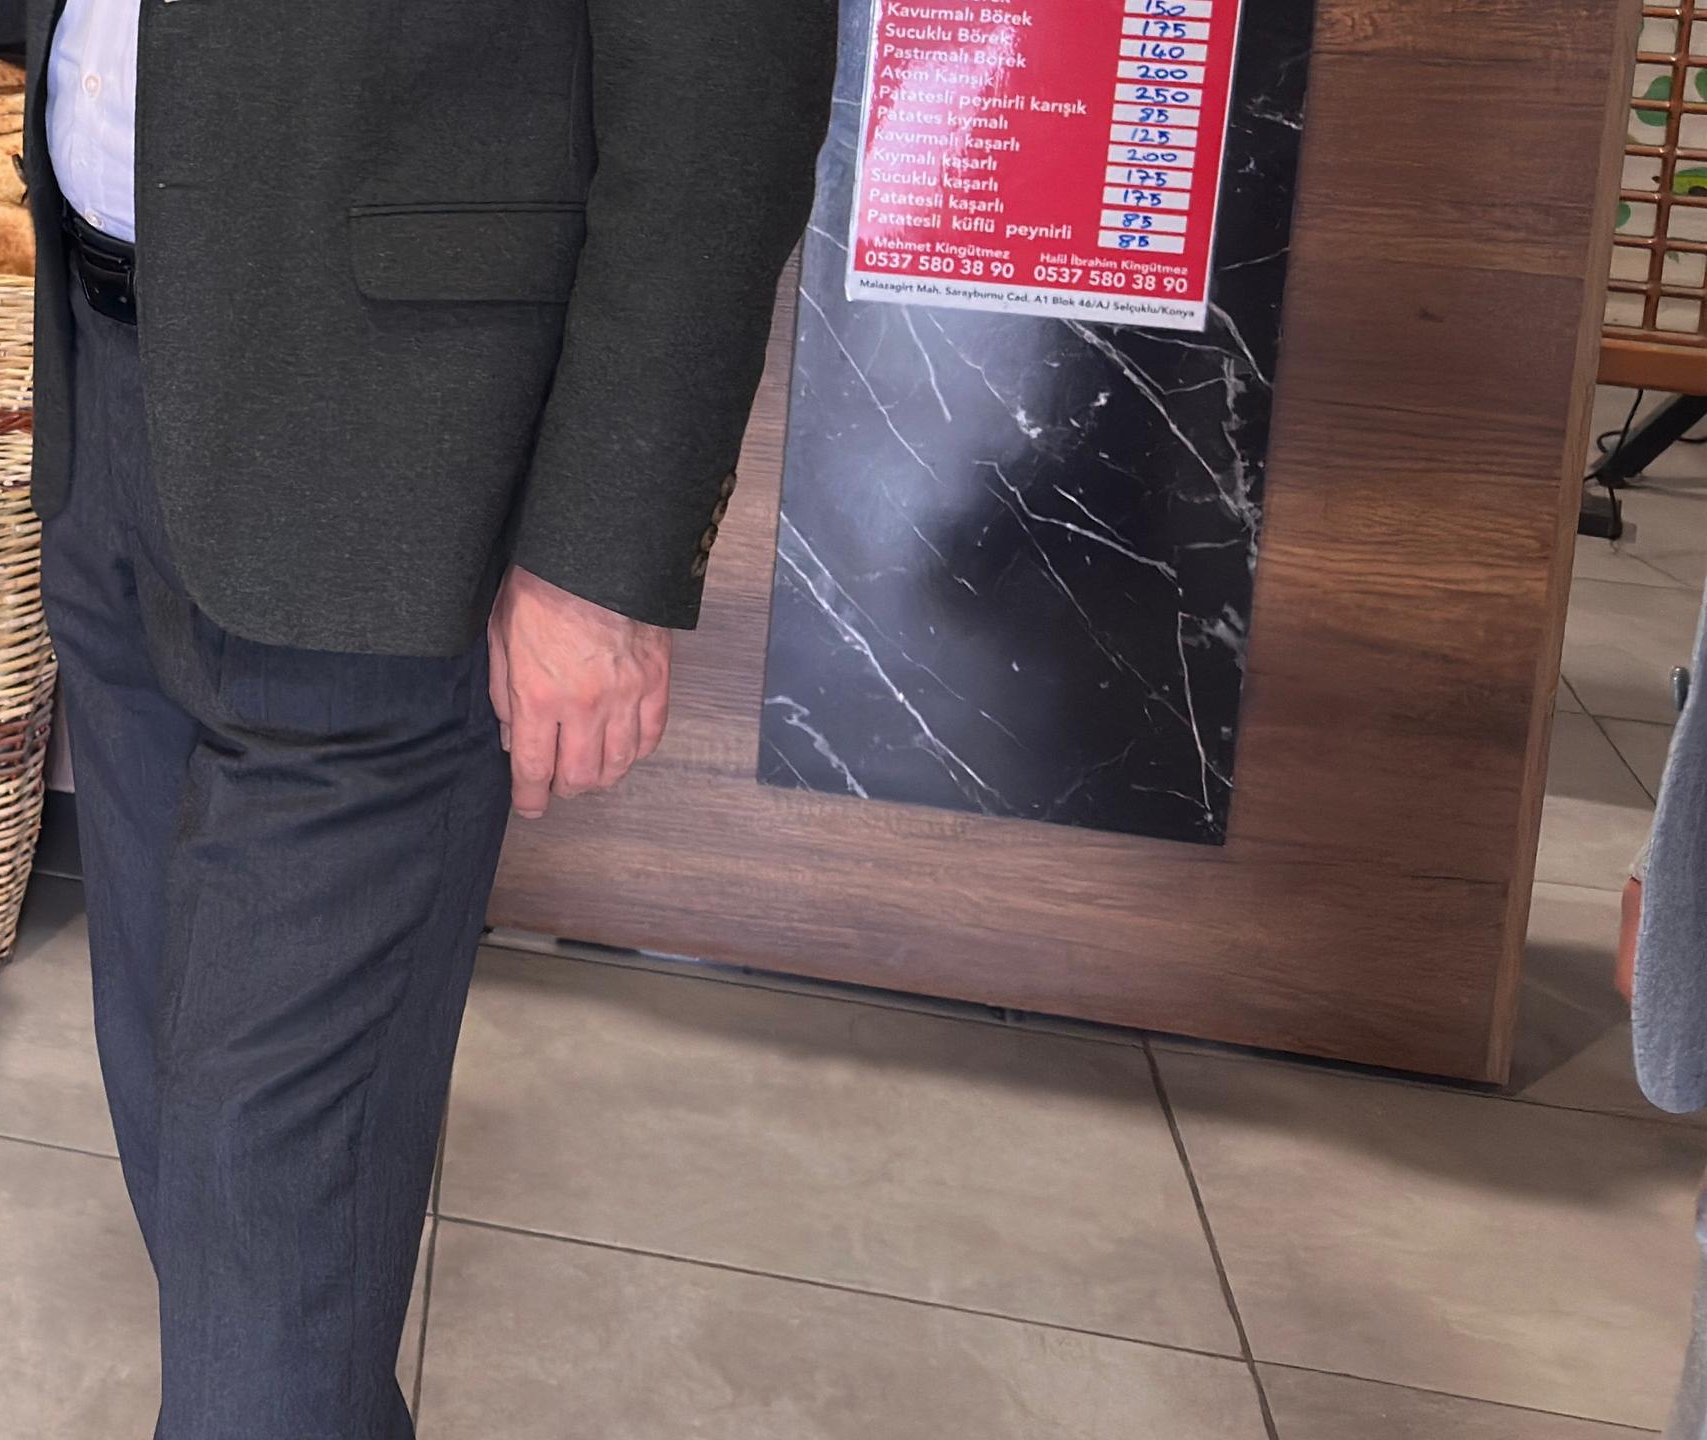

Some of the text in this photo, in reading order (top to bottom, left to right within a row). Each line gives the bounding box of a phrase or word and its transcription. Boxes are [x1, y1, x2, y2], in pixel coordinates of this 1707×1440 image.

[888, 2, 1033, 26] Kavurmalı Börek
[885, 23, 1013, 46] Sucuklu Börek
[1142, 20, 1187, 39] 175
[883, 44, 1027, 68] Pastırmalı Börek
[1140, 42, 1185, 60] 140
[880, 65, 929, 82] Atom
[1137, 64, 1188, 80] 200
[878, 85, 1087, 118] Patatesli peynirli karışık
[1135, 86, 1189, 104] 250
[877, 105, 1009, 130] Patates kıymalı
[964, 133, 1020, 152] kaşarlı
[1131, 127, 1170, 144] 125
[872, 147, 997, 172] Kıymalı kaşarlı
[1127, 148, 1177, 163] 200
[870, 168, 998, 192] Sucuklu kaşarlı
[1126, 169, 1167, 187] 175
[868, 189, 1004, 214] Patatesli kaşarlı
[1123, 189, 1162, 207] 175
[867, 209, 1073, 241] Patatesli küflü peynirli
[1122, 213, 1153, 229] 85
[873, 236, 1011, 260] Mehmet Kingütmez
[1118, 234, 1150, 249] 85
[864, 251, 1015, 279] 0537 580 38 90
[1040, 252, 1068, 264] Halil
[1120, 260, 1189, 276] Kingütmez
[1033, 265, 1188, 294] 0537 580 38 90
[916, 284, 942, 295] Mah.
[1034, 294, 1048, 304] A1
[1052, 296, 1076, 307] Blok
